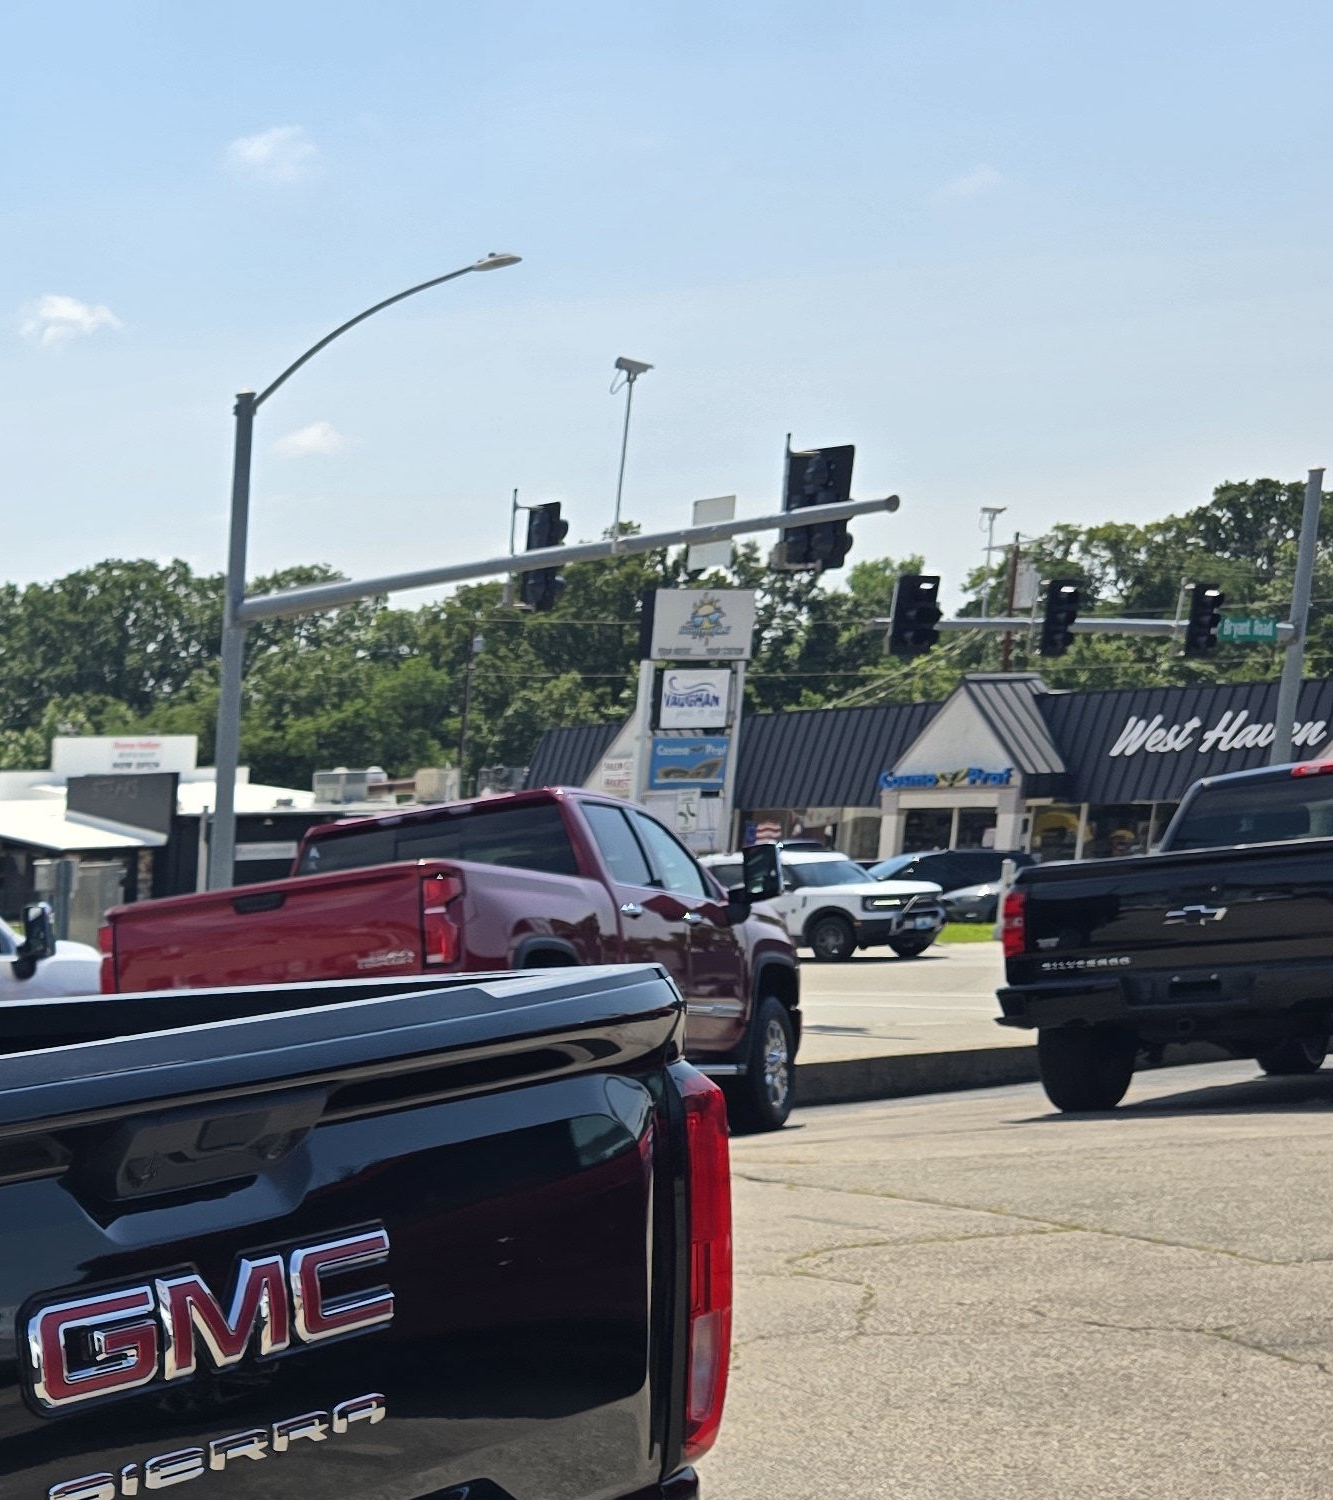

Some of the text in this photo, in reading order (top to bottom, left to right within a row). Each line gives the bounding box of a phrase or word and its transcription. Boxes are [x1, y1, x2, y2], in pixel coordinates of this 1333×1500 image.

[1223, 618, 1273, 640] Bryant Road
[664, 693, 720, 708] VAUGHAN
[1108, 714, 1202, 757] West
[879, 767, 1013, 788] Cosmo Prof
[28, 1228, 395, 1409] GMC
